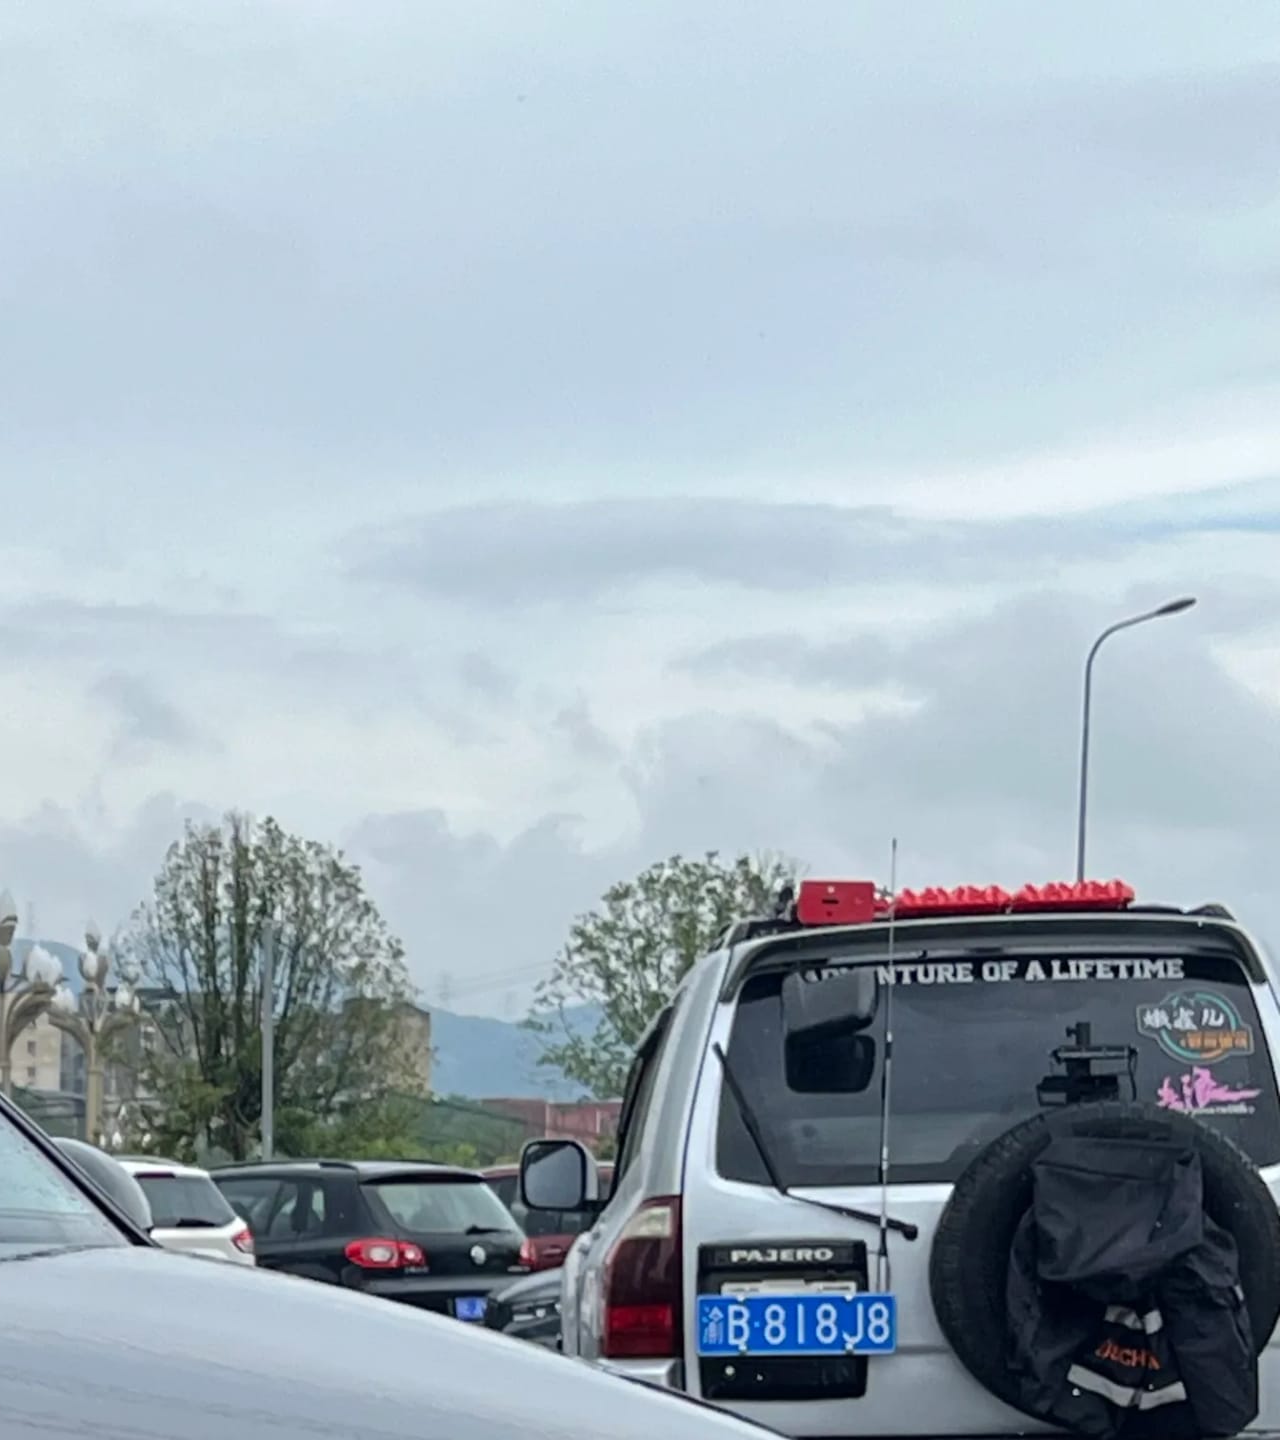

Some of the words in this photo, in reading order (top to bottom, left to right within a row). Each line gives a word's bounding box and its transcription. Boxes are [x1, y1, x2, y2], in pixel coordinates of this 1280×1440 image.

[981, 960, 1019, 982] OF
[1024, 960, 1047, 981] A
[1050, 958, 1185, 980] LIFETIME
[730, 1248, 834, 1263] PAJERO
